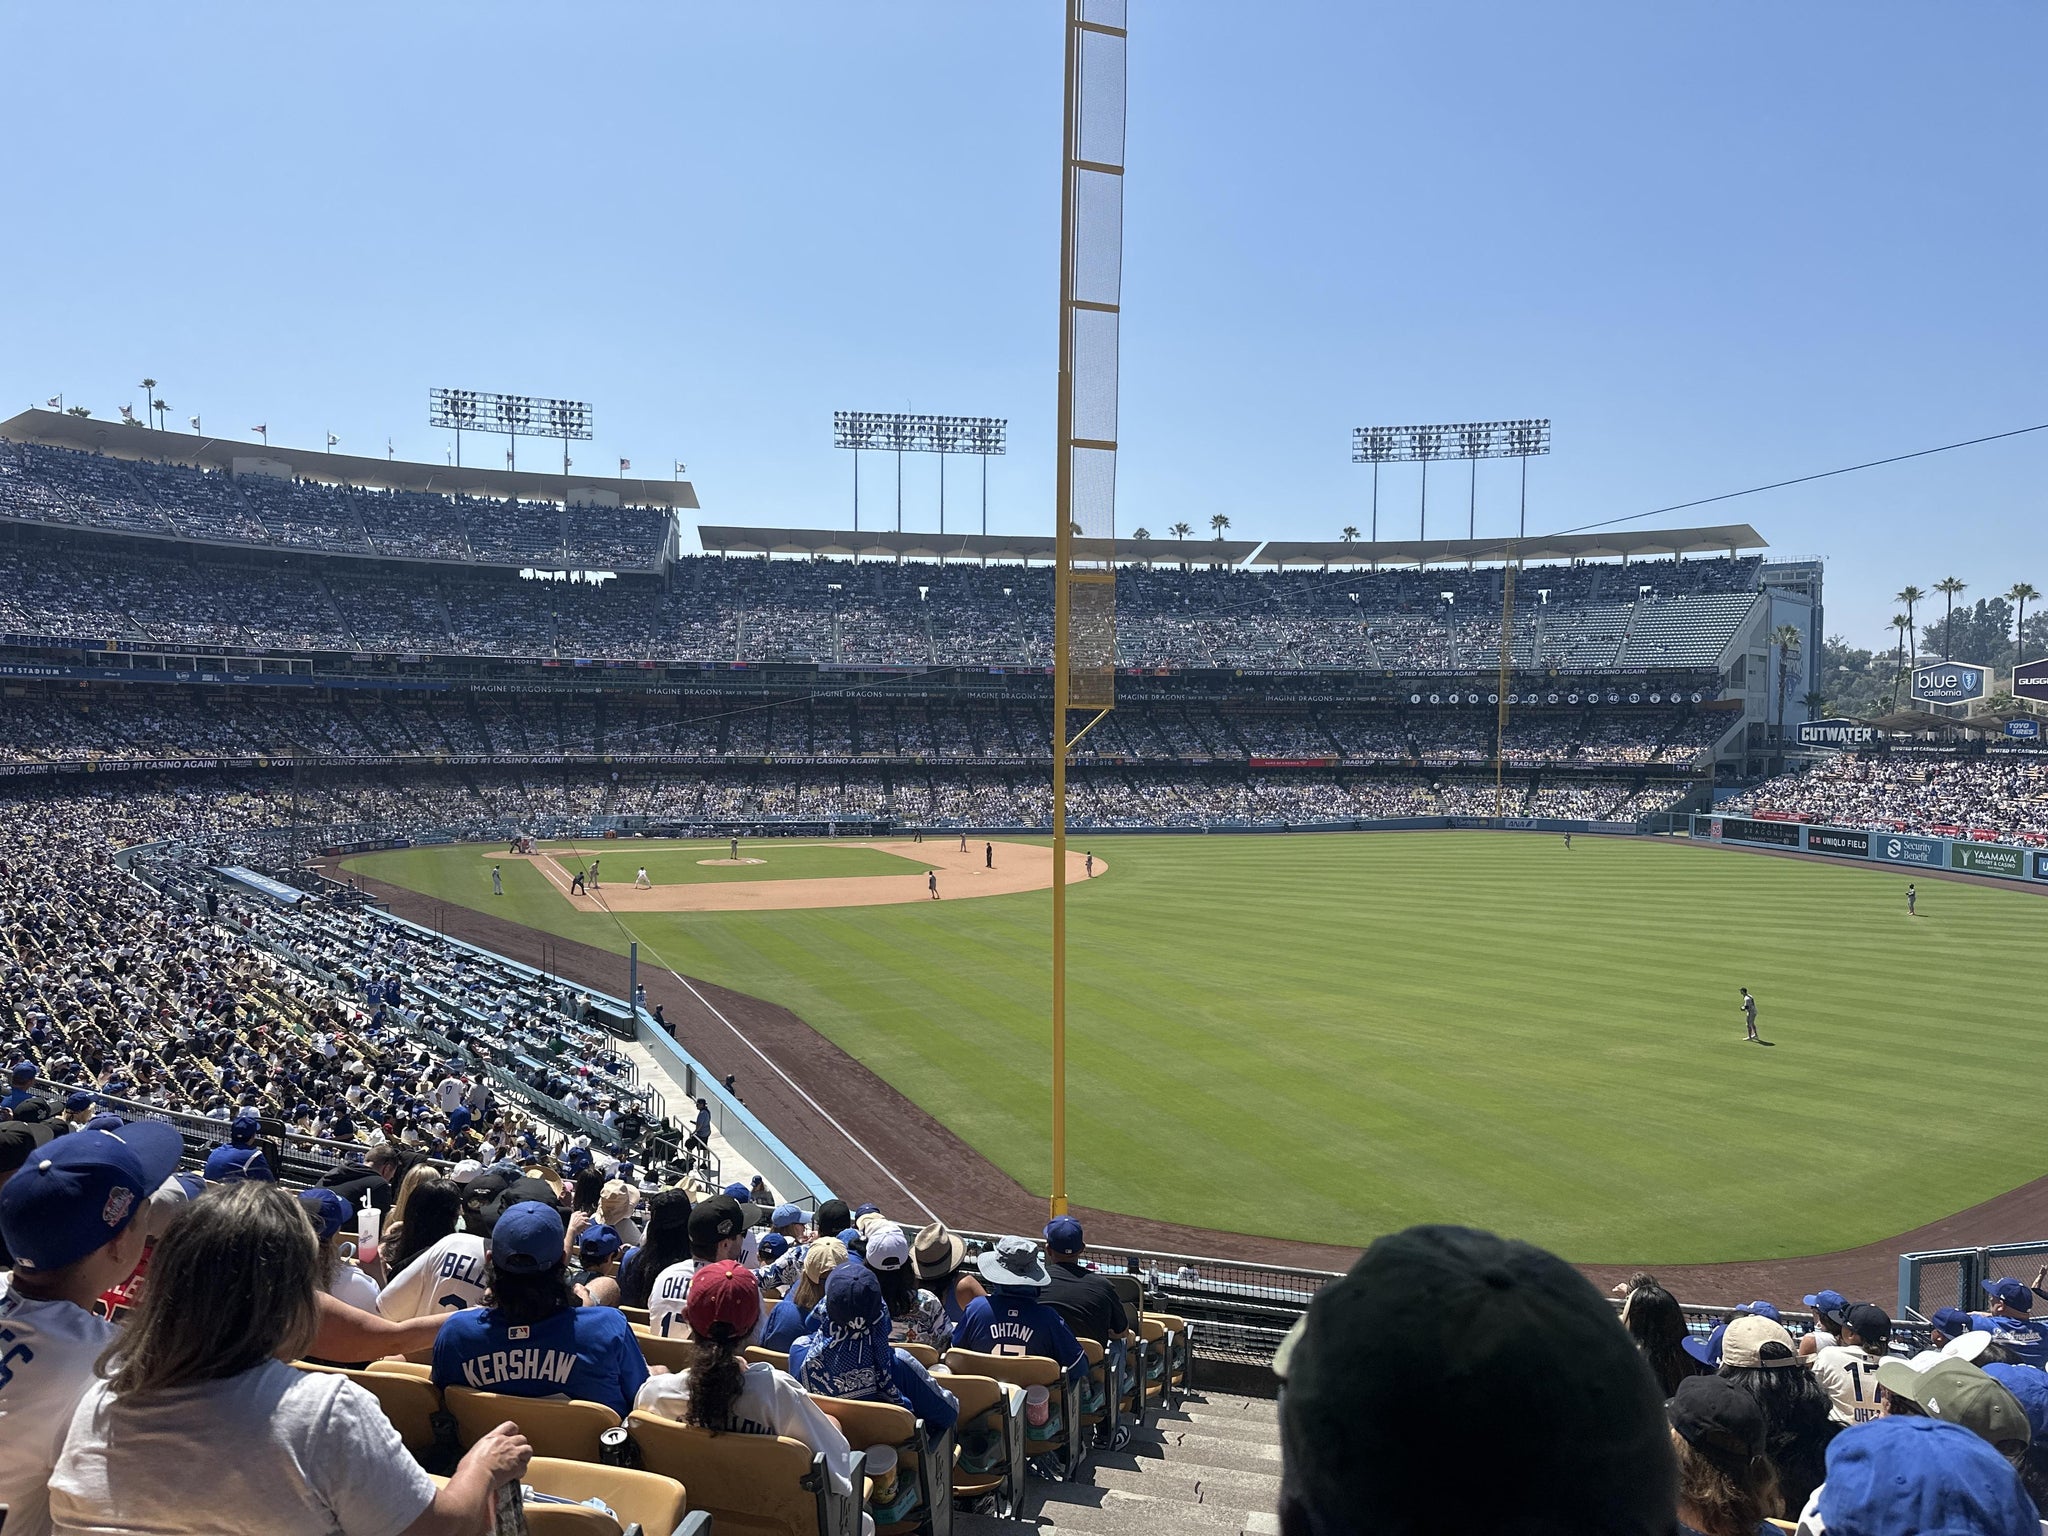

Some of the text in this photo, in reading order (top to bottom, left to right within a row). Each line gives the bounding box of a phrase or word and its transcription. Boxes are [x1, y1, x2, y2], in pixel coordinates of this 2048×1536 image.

[1919, 672, 1957, 689] blue
[1801, 727, 1872, 741] CUTWATER
[17, 765, 48, 775] AGAIN!
[99, 762, 130, 771] VOTED
[145, 761, 181, 769] CASINO
[183, 760, 217, 768] AGAIN!
[1744, 828, 1783, 837] DRAGONS
[1823, 838, 1866, 848] UNIQLO FIELD
[1904, 841, 1932, 852] Security
[1904, 850, 1928, 862] Benefit
[990, 1322, 1034, 1343] OHTANI
[462, 1349, 577, 1388] KERSHAW
[1844, 1362, 1881, 1403] 17
